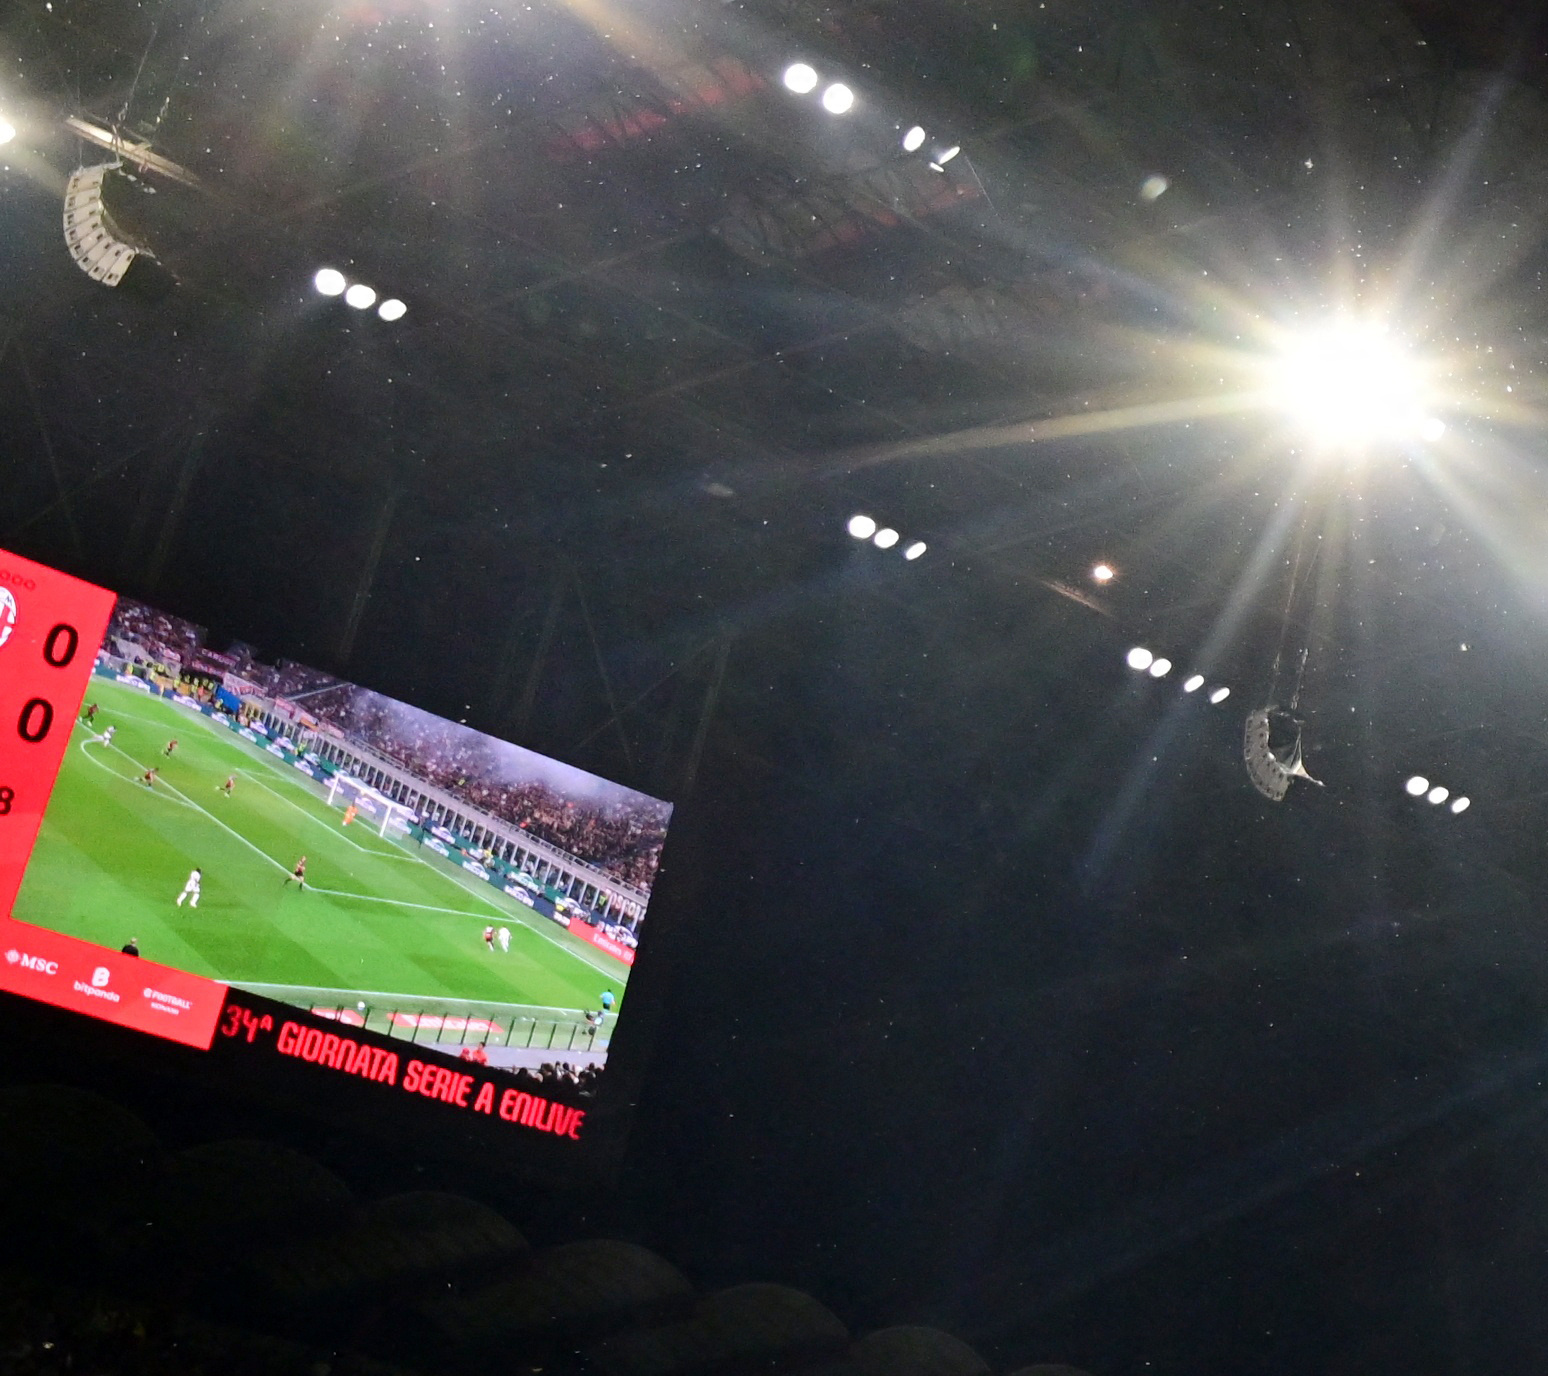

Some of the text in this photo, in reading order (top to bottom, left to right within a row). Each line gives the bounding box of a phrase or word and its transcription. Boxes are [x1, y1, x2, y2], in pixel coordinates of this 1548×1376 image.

[43, 624, 79, 668] 0
[17, 698, 54, 742] 0
[20, 953, 59, 975] MSC
[74, 980, 120, 1003] bitpanda
[277, 1020, 399, 1086] GIORNATA
[403, 1060, 474, 1108] SERIE
[474, 1081, 494, 1114] A
[500, 1087, 585, 1141] ENILIVE
